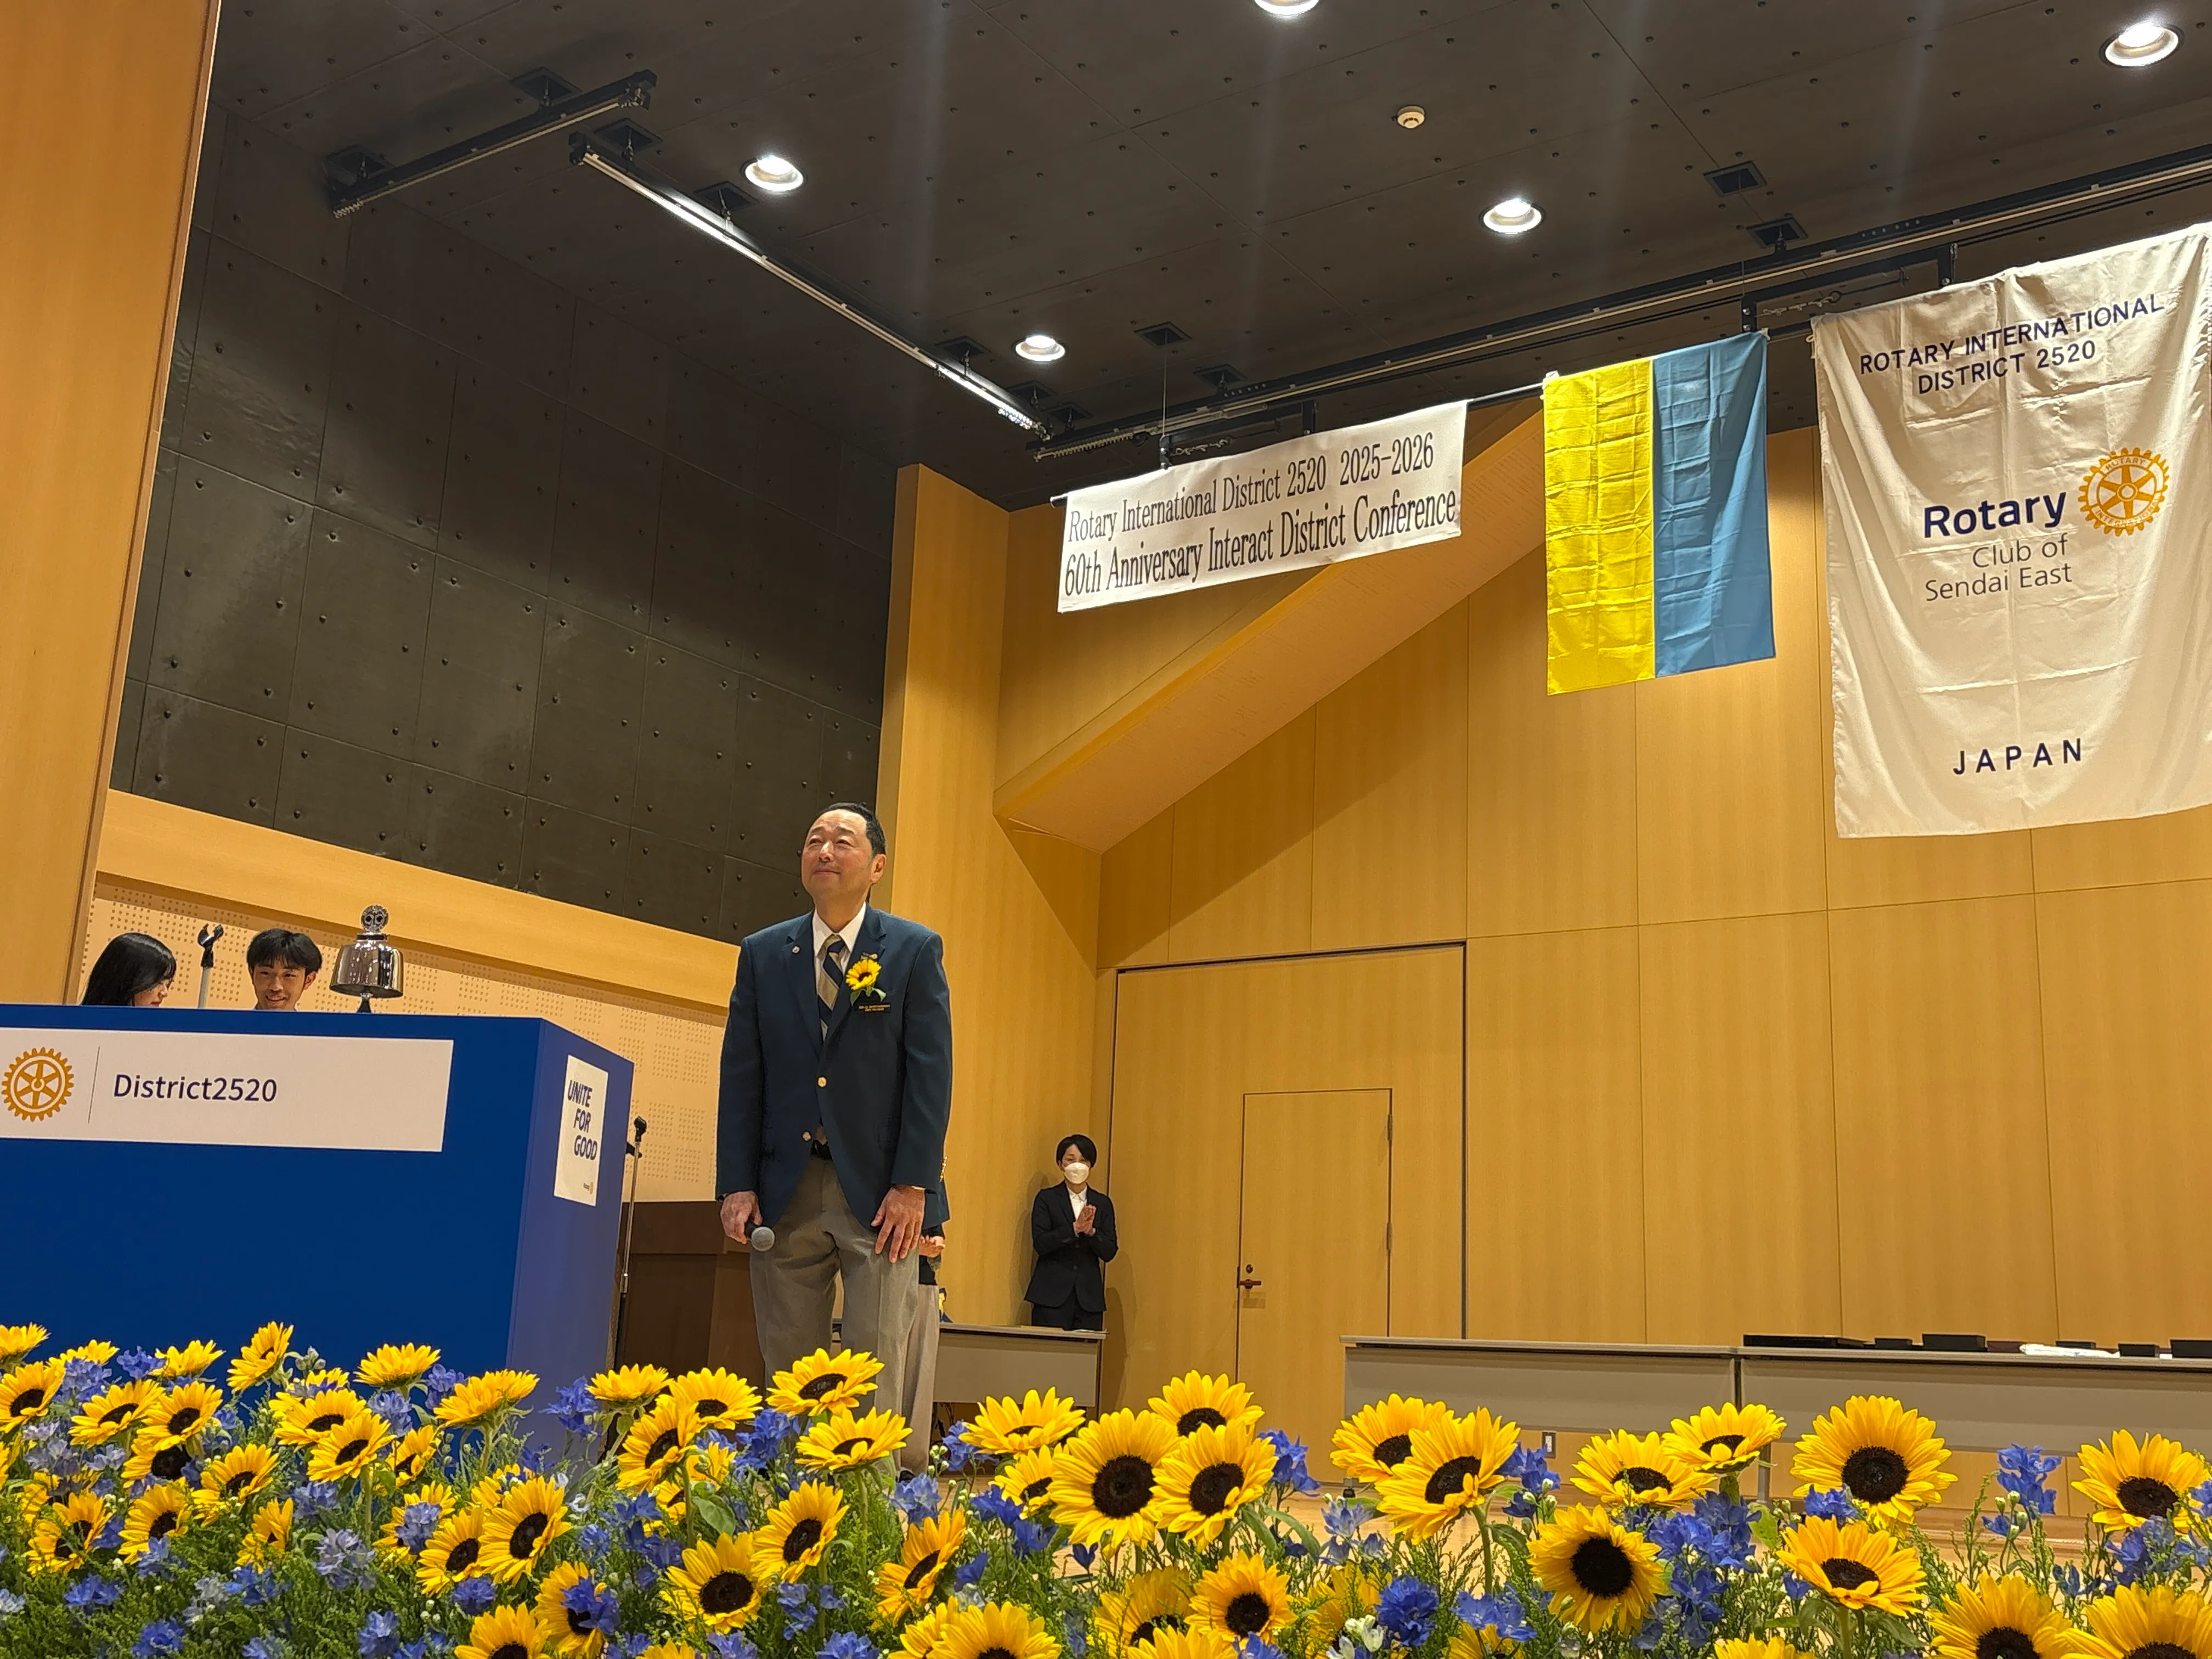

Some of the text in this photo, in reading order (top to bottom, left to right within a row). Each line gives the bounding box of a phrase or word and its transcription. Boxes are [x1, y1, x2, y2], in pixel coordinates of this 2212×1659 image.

[1860, 294, 2165, 374] ROTARY INTERNATIONAL
[1918, 340, 2096, 394] DISTRICT 2520
[2105, 457, 2146, 471] ROTARY
[1068, 432, 1434, 543] Rotary International District 2520 2025-2026
[1924, 492, 2067, 538] Rotary
[1064, 489, 1456, 596] 60th Anniversary Interact District Conference
[1973, 532, 2068, 568] Club of
[1925, 563, 2073, 601] Sendai East
[1953, 737, 2081, 775] JAPAN
[114, 1074, 277, 1102] District2520
[567, 1079, 593, 1108] UNITE
[573, 1107, 591, 1133] FOR
[574, 1135, 598, 1161] GOOD
